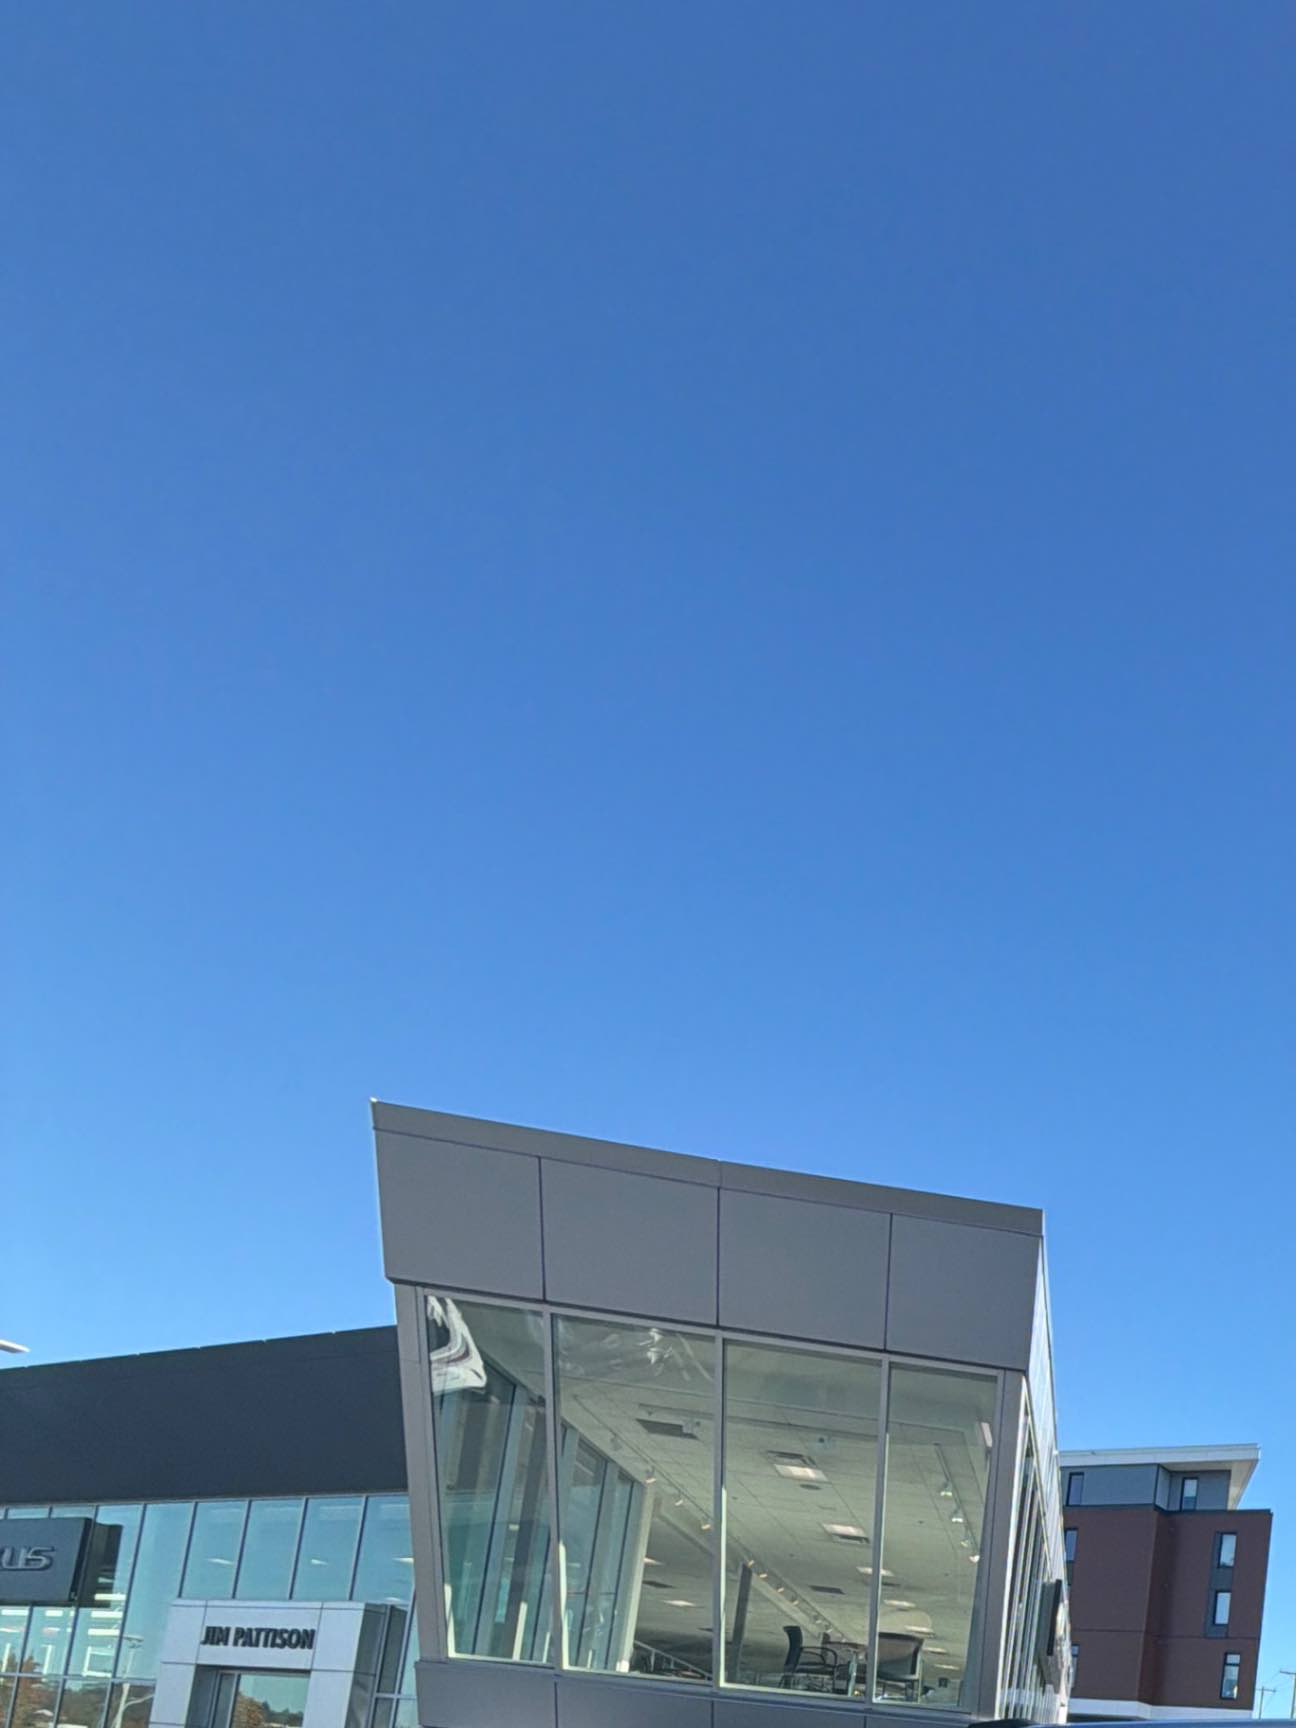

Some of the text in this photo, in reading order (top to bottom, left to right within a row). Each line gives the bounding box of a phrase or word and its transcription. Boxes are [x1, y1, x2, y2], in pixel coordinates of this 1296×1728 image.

[0, 1545, 55, 1571] US
[200, 1626, 316, 1649] JIM PATTISON
